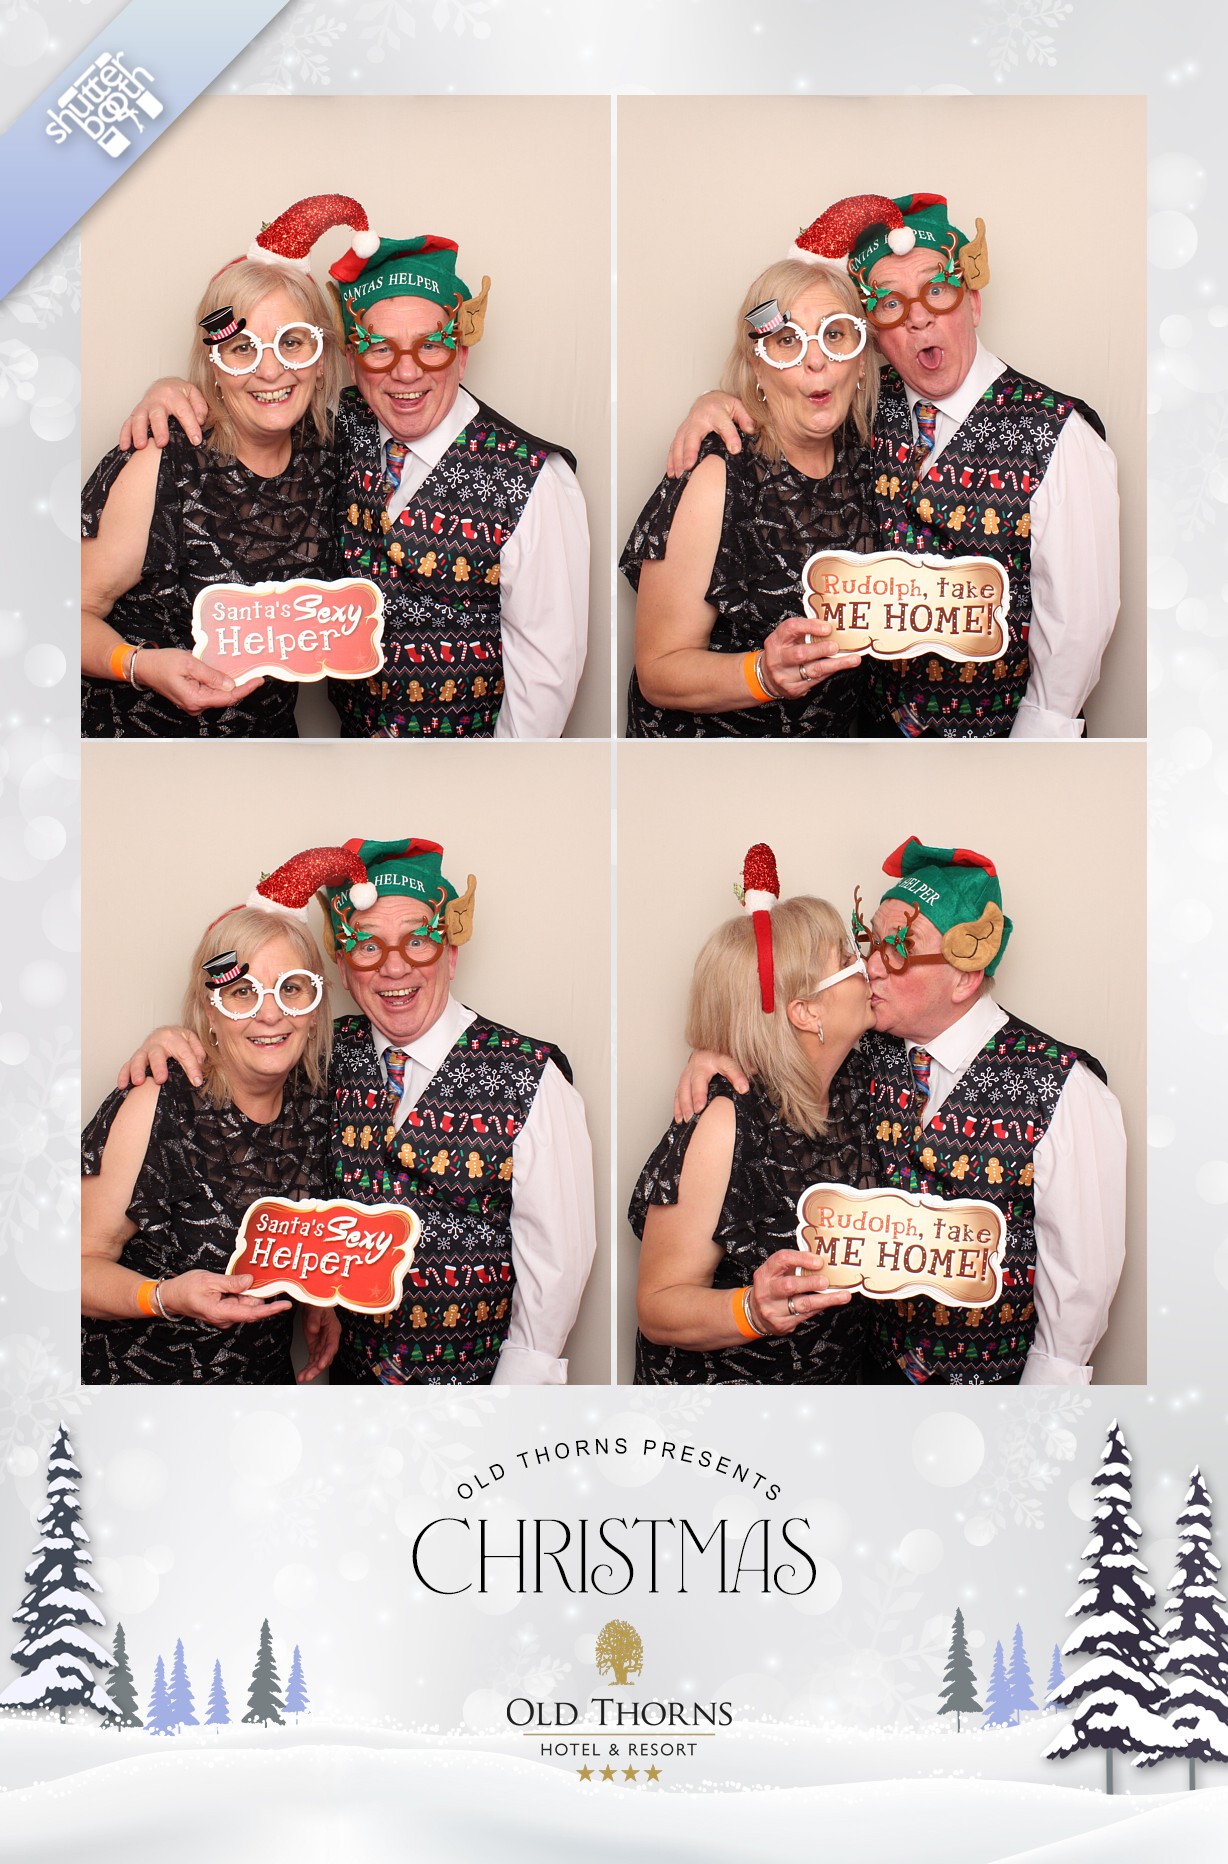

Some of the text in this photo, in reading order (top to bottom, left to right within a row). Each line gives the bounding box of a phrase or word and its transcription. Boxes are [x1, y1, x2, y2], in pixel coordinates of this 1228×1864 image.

[851, 238, 880, 271] ANTAS
[388, 272, 441, 294] HELPER
[822, 573, 995, 600] Rudolph, take
[212, 594, 362, 636] Santa's Sexy
[821, 601, 993, 636] ME HOME!
[215, 625, 341, 661] Helper
[374, 873, 426, 893] HELPER
[899, 877, 941, 907] HELPER
[256, 1213, 393, 1264] Santa's Sexy
[817, 1206, 992, 1243] Rudolph, take
[250, 1238, 364, 1279] Helper
[815, 1236, 989, 1281] ME HOME!
